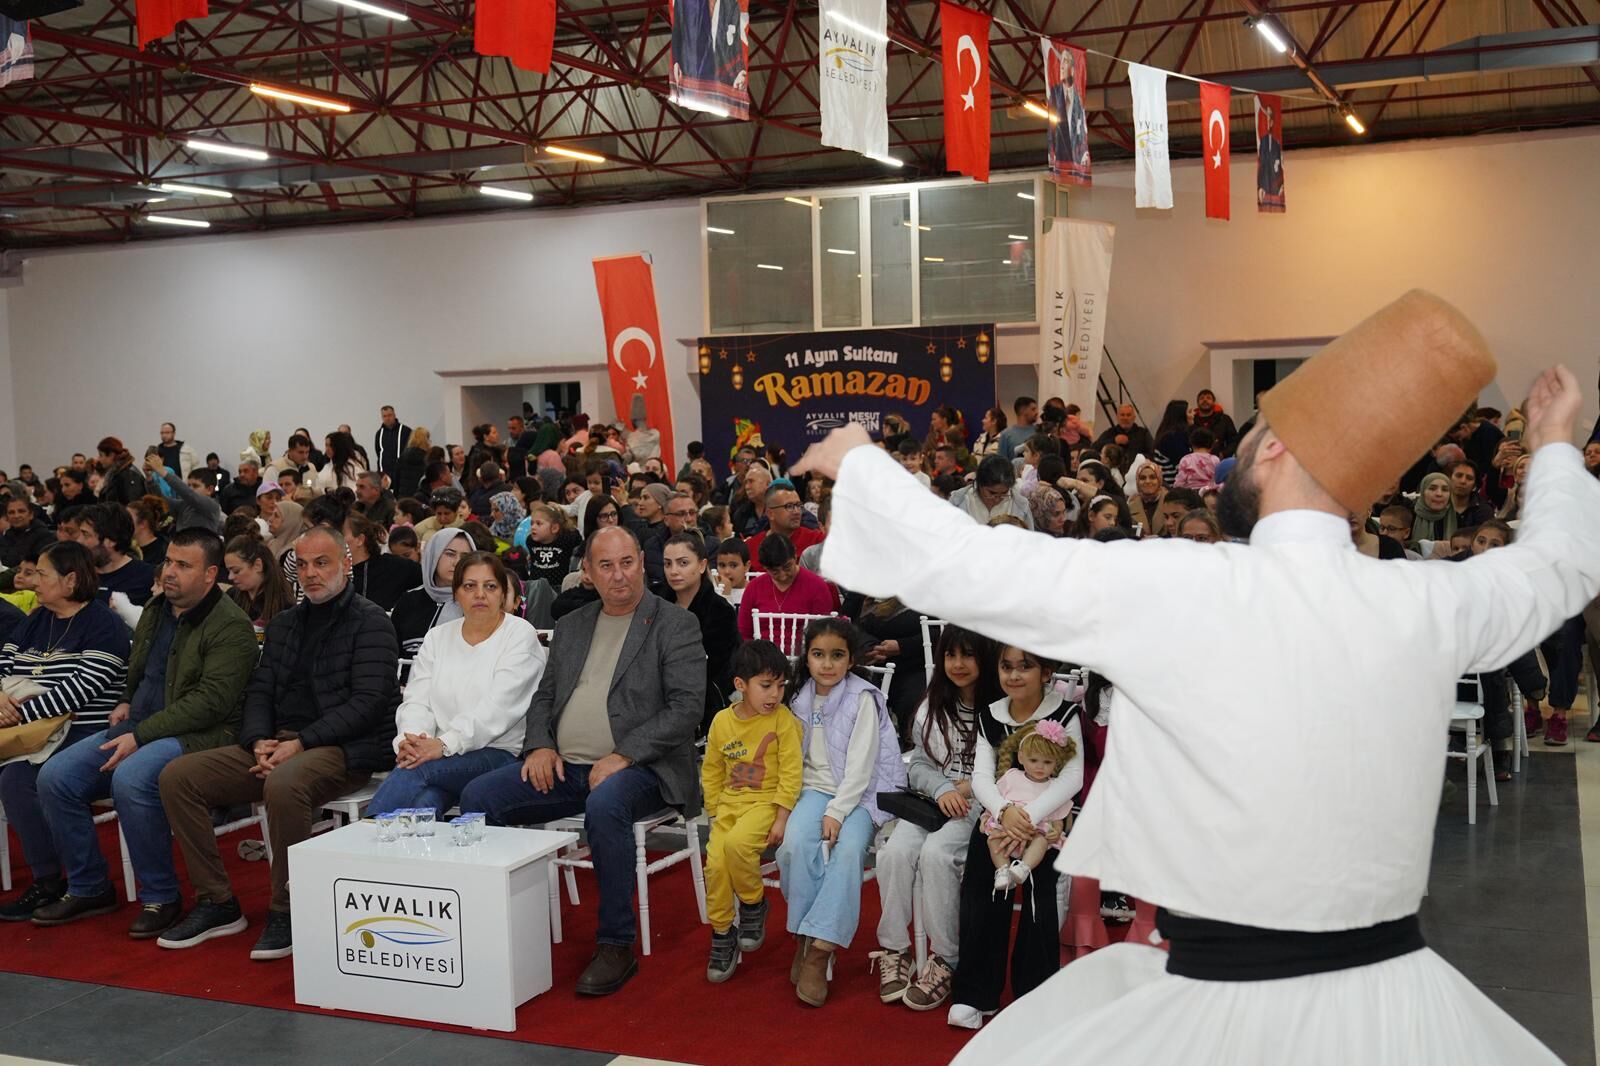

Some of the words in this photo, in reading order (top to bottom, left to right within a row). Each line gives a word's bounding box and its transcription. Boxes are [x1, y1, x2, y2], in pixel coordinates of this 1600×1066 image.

[824, 28, 877, 57] AYVALIK
[785, 352, 800, 369] 11
[804, 349, 838, 368] Ayın
[843, 345, 899, 364] Sultanı
[753, 369, 931, 408] Ramazan
[806, 412, 845, 420] AYVALIK
[848, 411, 880, 422] MESUT
[723, 749, 748, 760] OAR
[345, 892, 453, 920] AYVALIK
[346, 948, 455, 974] BELEDİYESİ
